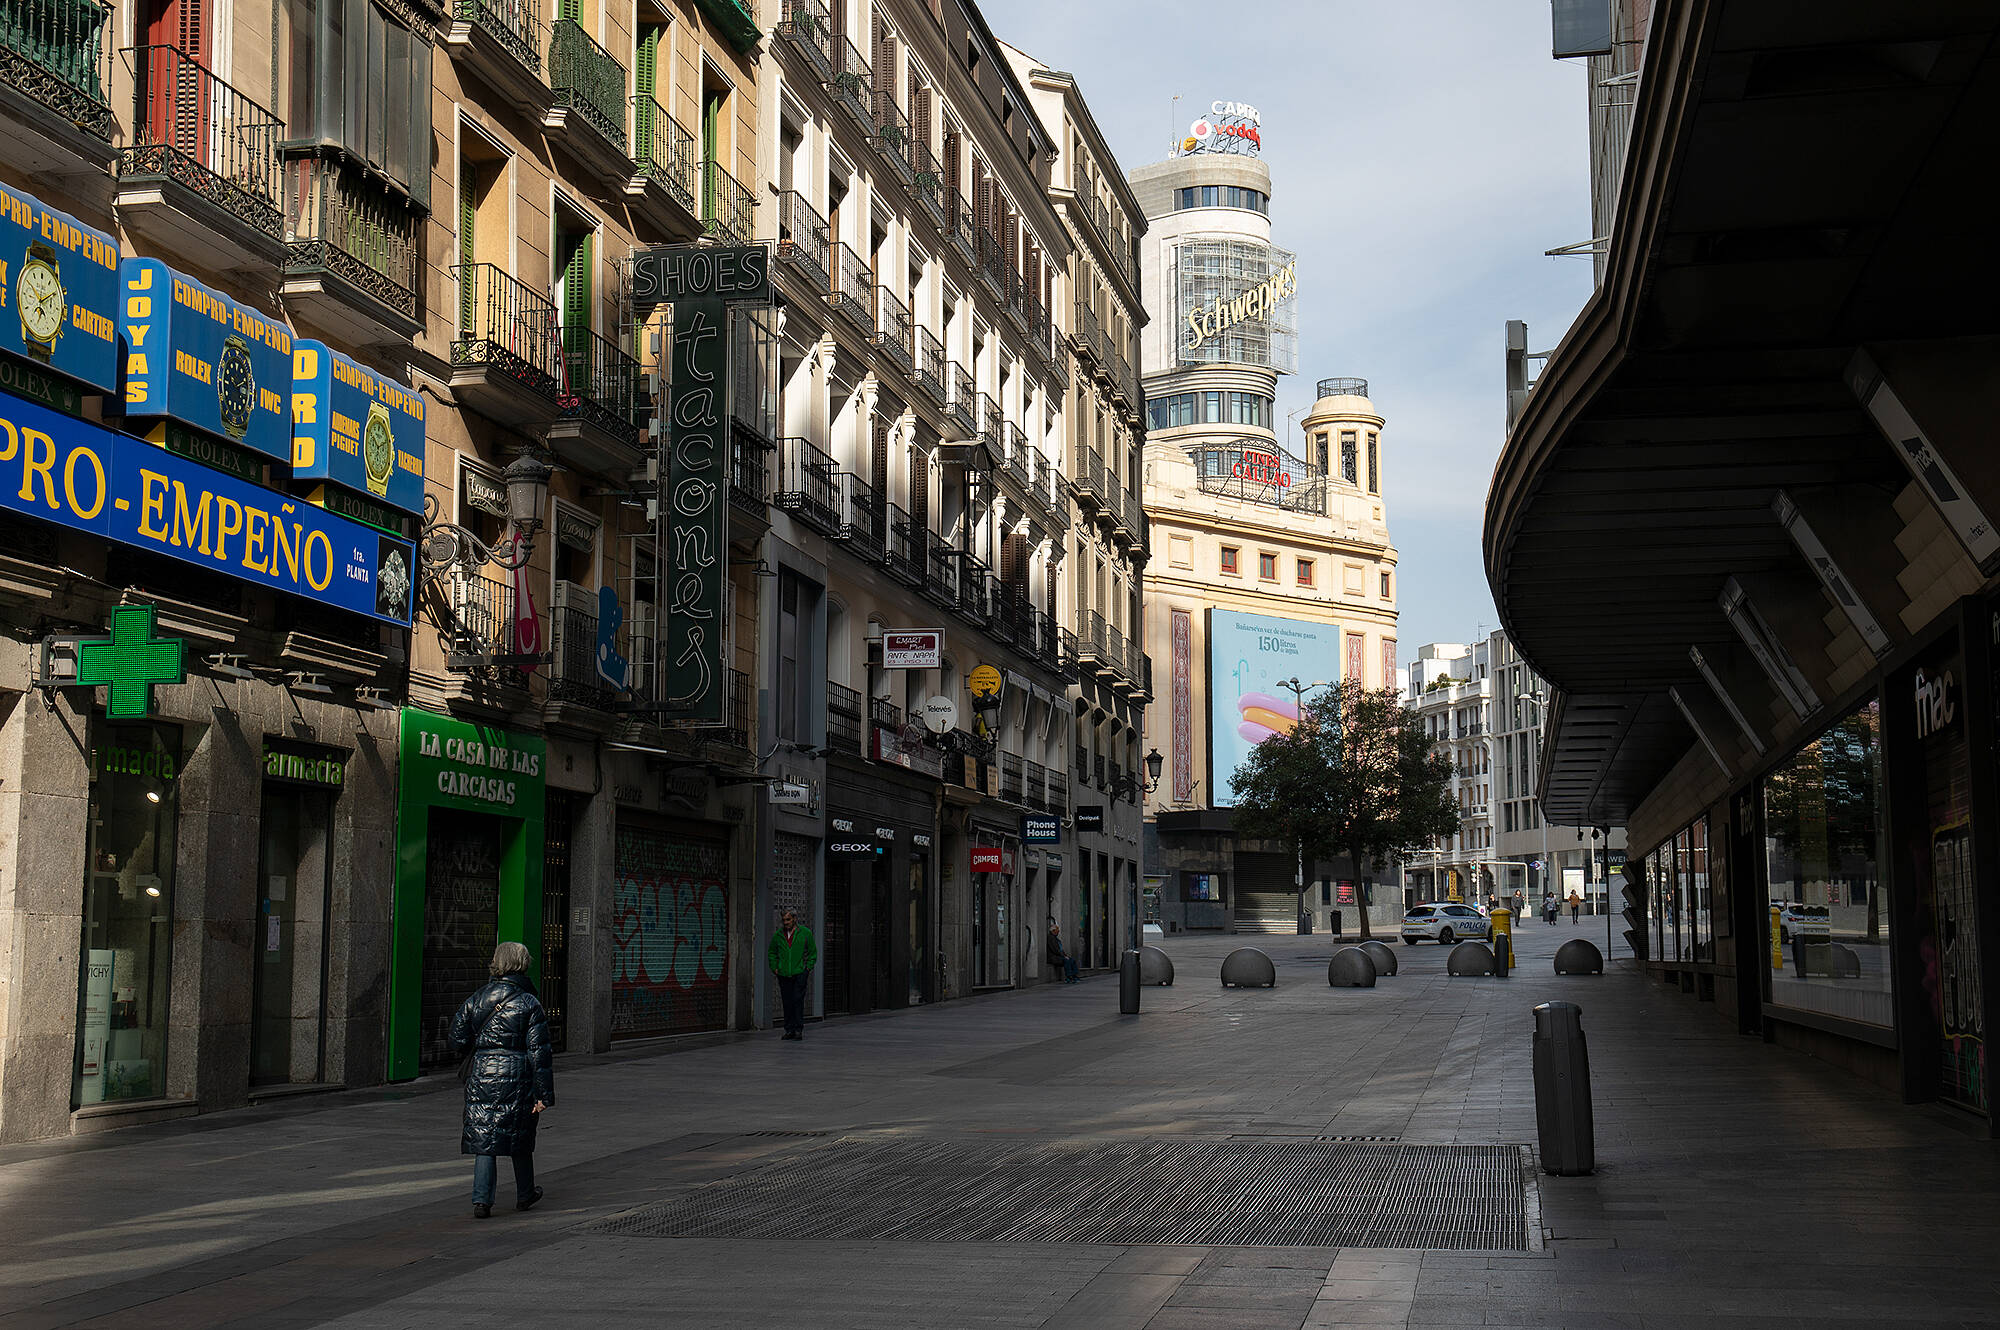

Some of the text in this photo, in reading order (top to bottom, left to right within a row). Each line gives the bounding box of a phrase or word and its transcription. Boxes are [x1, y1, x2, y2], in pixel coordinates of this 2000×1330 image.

[634, 251, 763, 297] SHOES
[173, 278, 291, 356] COMPRO-EMPEÑO
[1188, 260, 1297, 350] Schweppes
[72, 304, 114, 343] CARTIER
[126, 268, 153, 403] JOYAS
[176, 349, 212, 385] ROLEX
[260, 387, 281, 415] IWC
[333, 357, 424, 422] COMPRO-EMPEÑO
[292, 349, 318, 468] ORO
[188, 435, 243, 474] ROLEX
[331, 431, 360, 457] PIGUET
[1244, 450, 1280, 468] CINES
[1233, 462, 1291, 488] CALLAO
[343, 495, 385, 527] ROLEX
[668, 311, 718, 703] tacones
[346, 563, 370, 584] PLANTA
[1259, 635, 1280, 652] 150
[927, 705, 952, 713] Televés
[1915, 667, 1954, 740] fnac
[419, 731, 442, 758] LA
[446, 738, 486, 766] CASA
[489, 746, 509, 770] DE
[511, 750, 539, 777] LAS
[438, 771, 516, 805] CARCASAS
[1026, 820, 1057, 829] Phone
[1026, 829, 1057, 837] House
[830, 843, 873, 852] GEOX
[972, 855, 999, 865] CAMPER
[87, 967, 110, 978] VICHY
